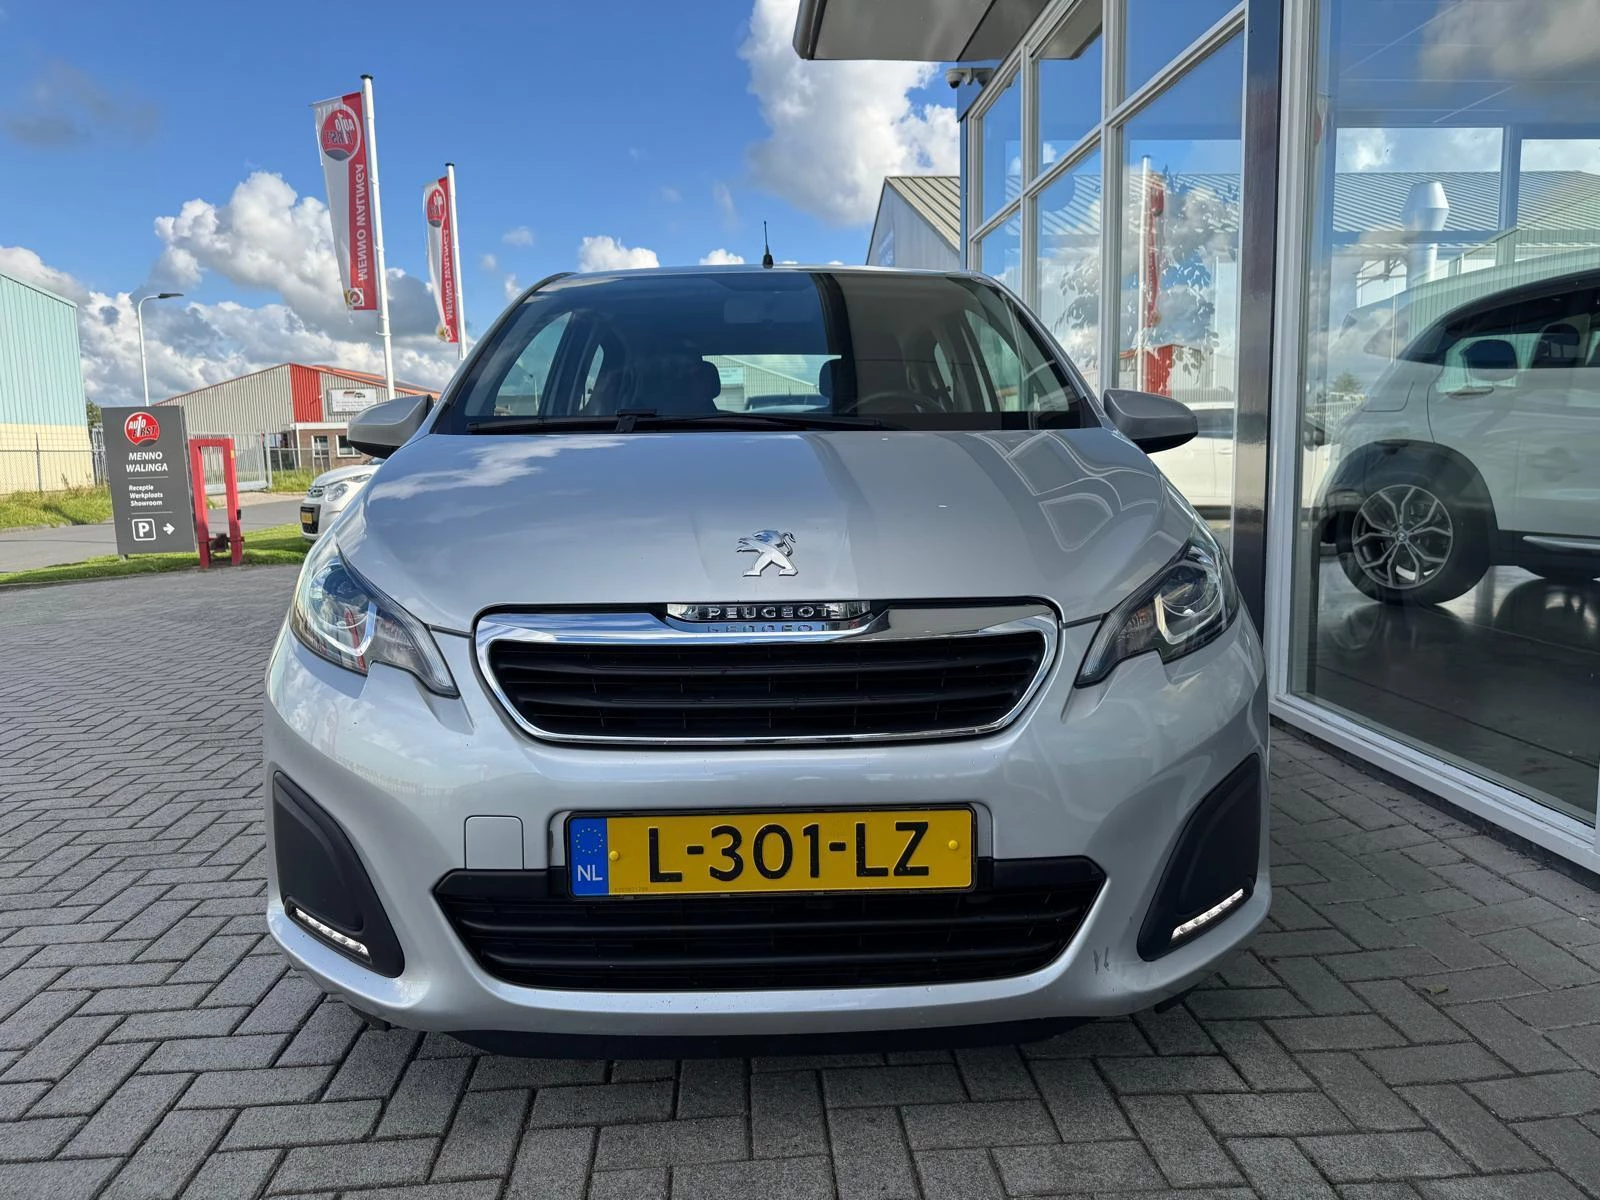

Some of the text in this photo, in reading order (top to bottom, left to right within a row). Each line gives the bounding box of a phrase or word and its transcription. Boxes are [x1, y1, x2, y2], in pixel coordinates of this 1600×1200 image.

[128, 451, 163, 461] MENNO
[125, 462, 168, 473] WALINGA
[128, 484, 154, 492] Receptie
[129, 492, 164, 500] Werkplaats
[137, 522, 150, 538] P
[707, 605, 832, 620] PEUGEOT
[648, 821, 929, 883] L-301-LZ
[577, 864, 603, 882] NL
